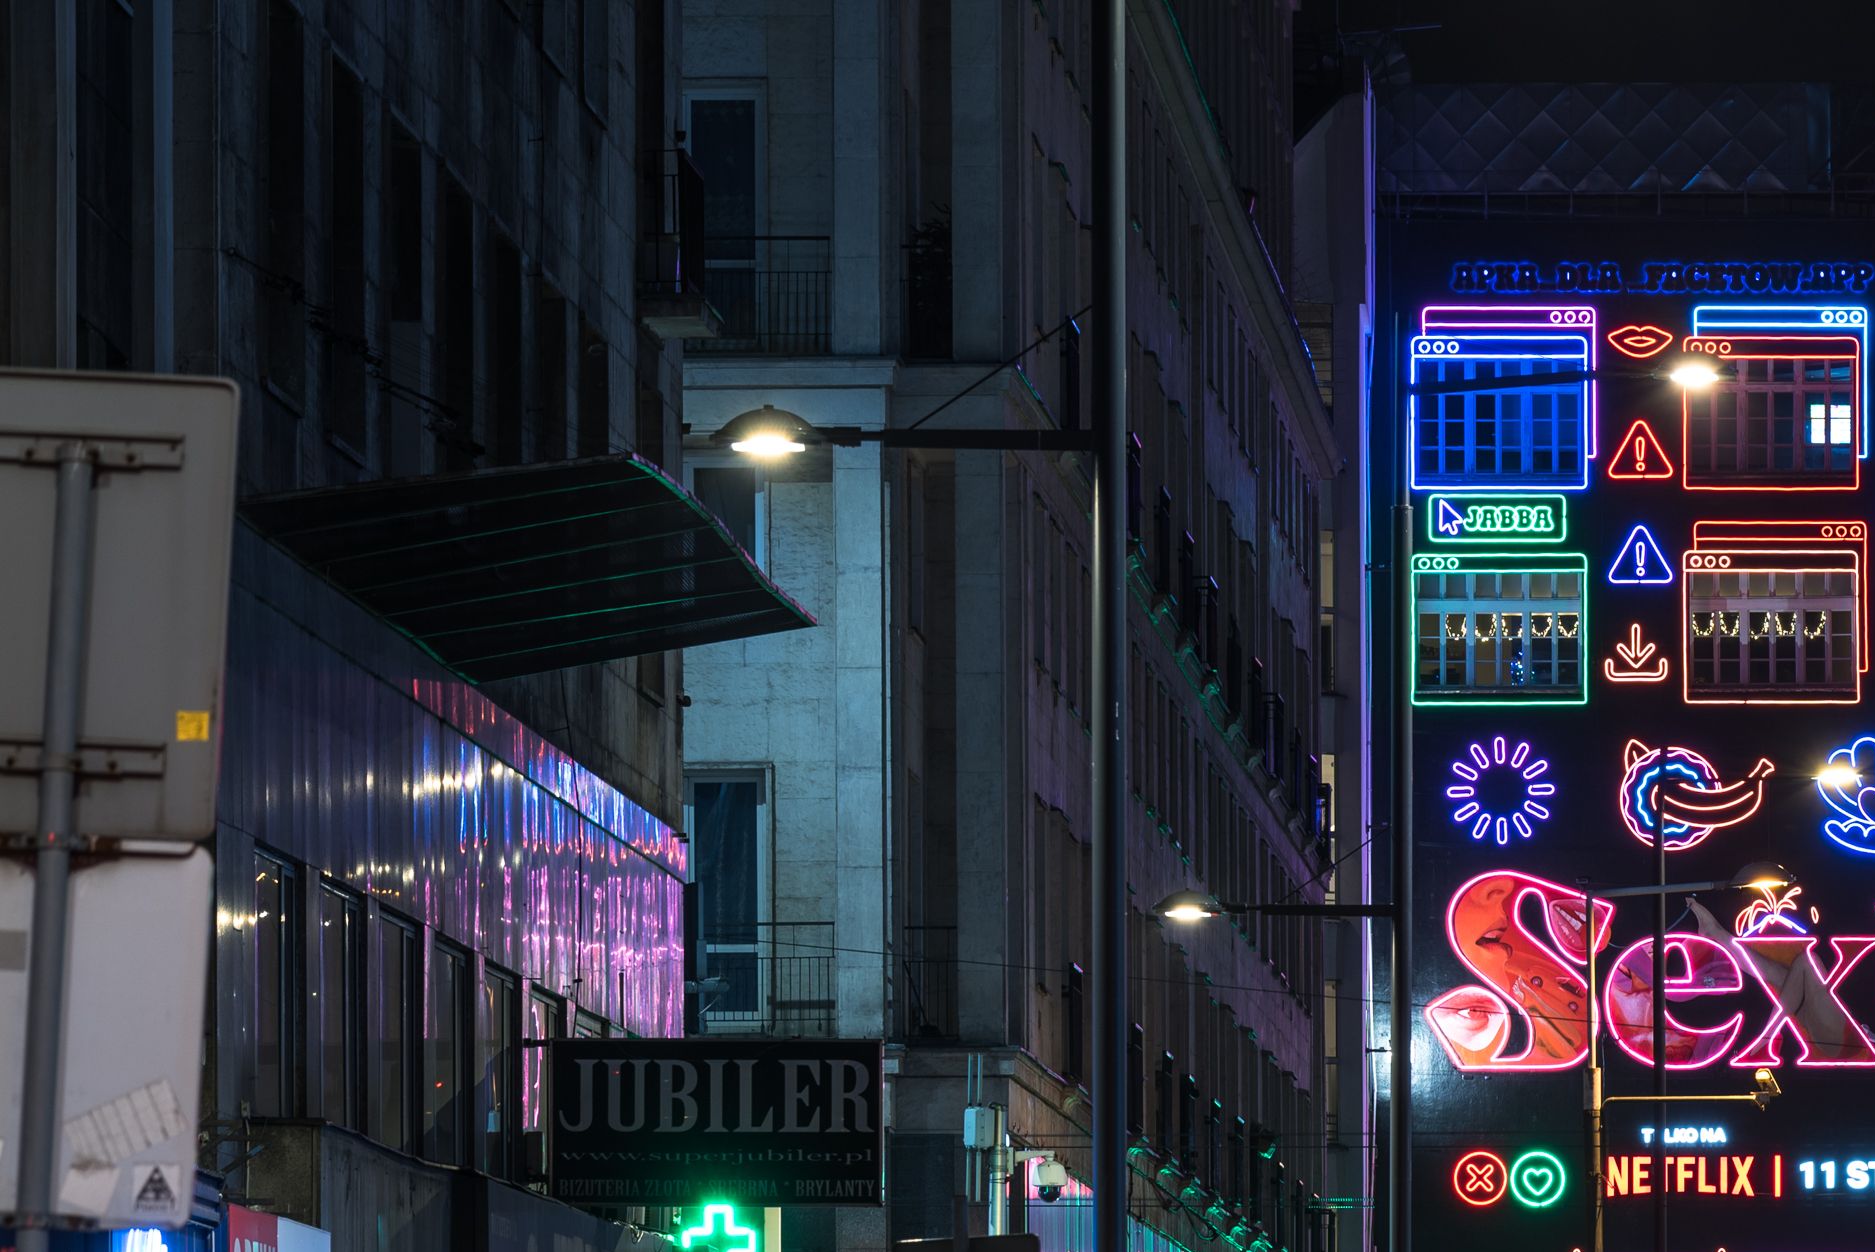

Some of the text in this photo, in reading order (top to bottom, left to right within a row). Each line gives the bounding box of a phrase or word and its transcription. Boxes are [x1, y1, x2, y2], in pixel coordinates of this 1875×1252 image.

[1463, 505, 1554, 532] JABBA
[558, 1058, 876, 1134] JUBILER
[1640, 1126, 1727, 1144] TLKO NA
[560, 1149, 874, 1166] www.superjubiler.pl
[1799, 1159, 1836, 1190] 11
[794, 1178, 876, 1198] BRYLANTY
